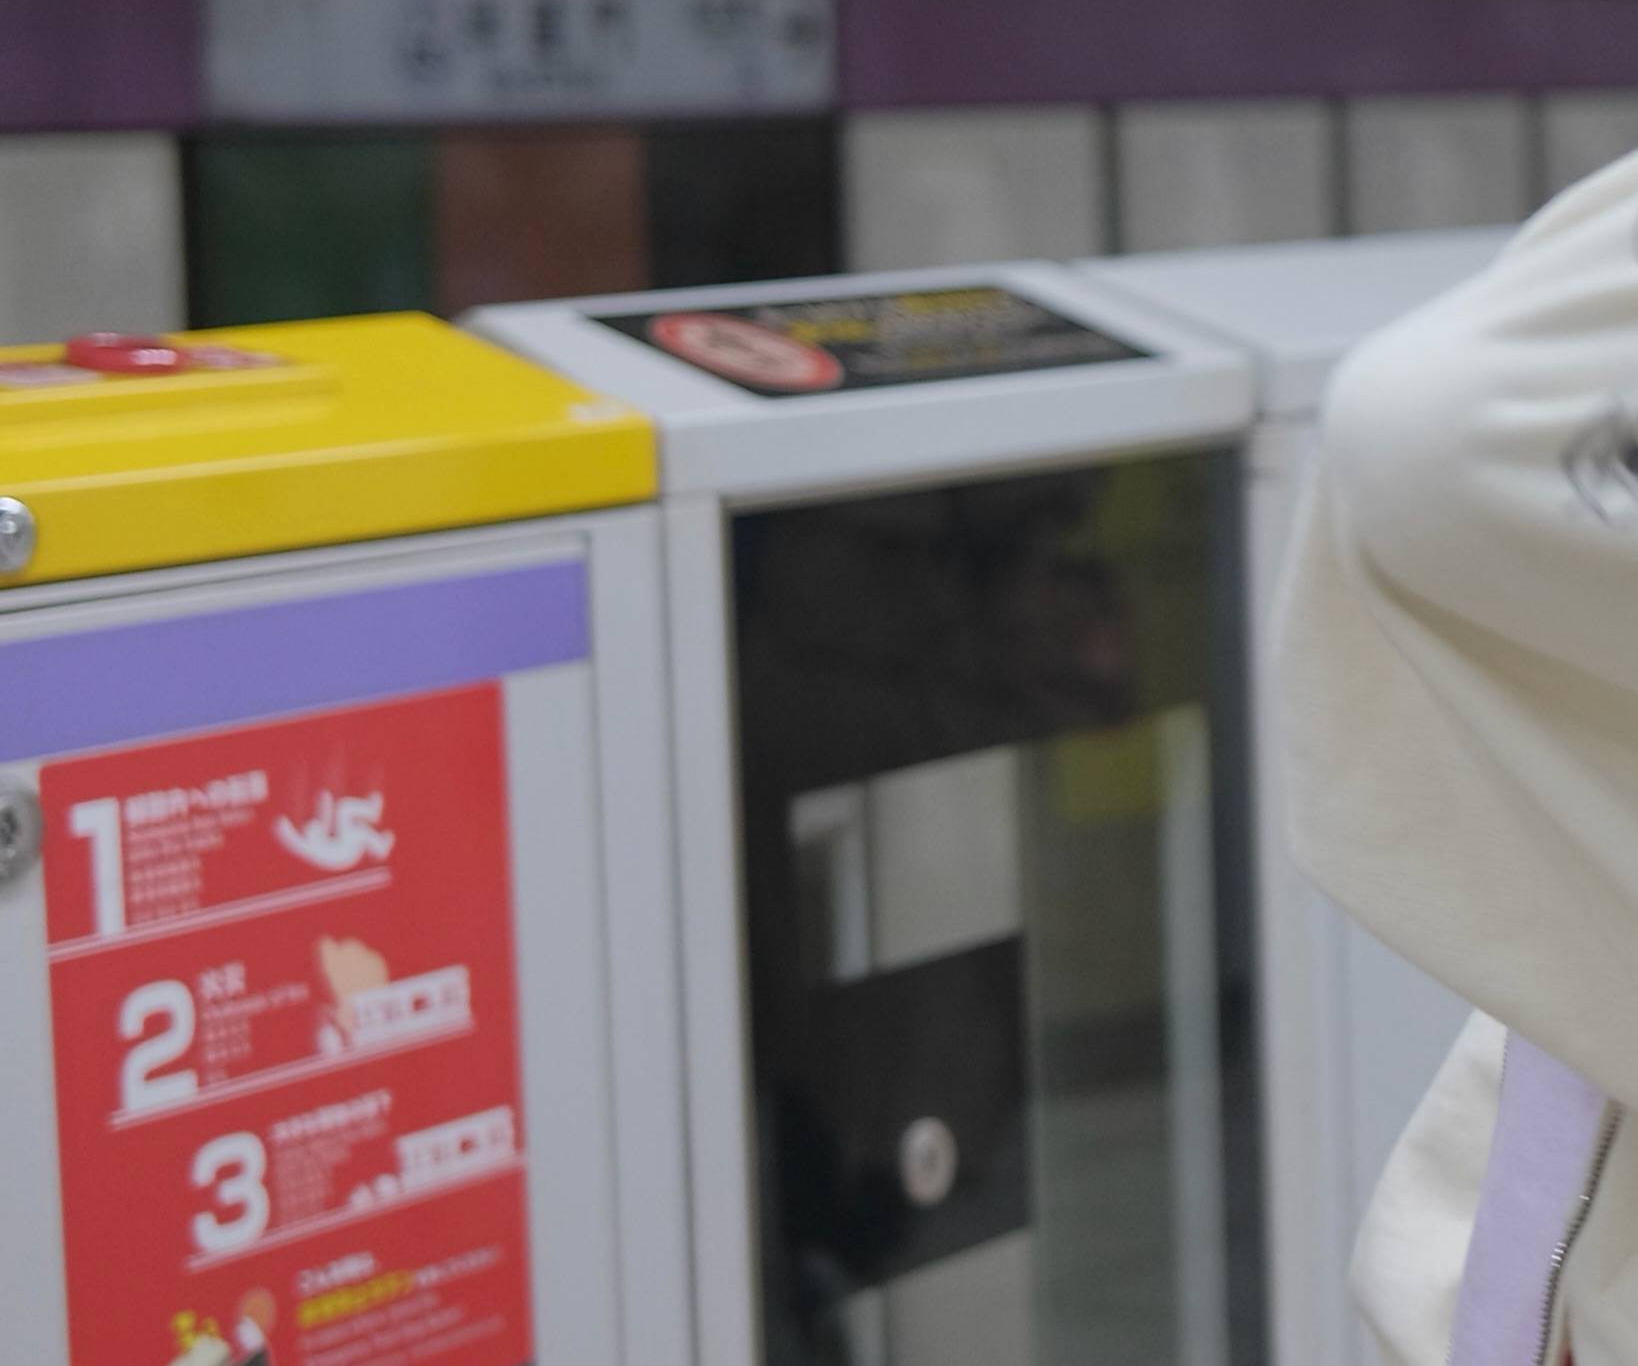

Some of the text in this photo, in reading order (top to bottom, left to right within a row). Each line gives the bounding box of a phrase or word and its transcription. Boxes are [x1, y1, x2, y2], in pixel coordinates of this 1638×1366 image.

[70, 796, 125, 935] 1
[119, 979, 199, 1113] 2
[190, 1131, 270, 1251] 3
